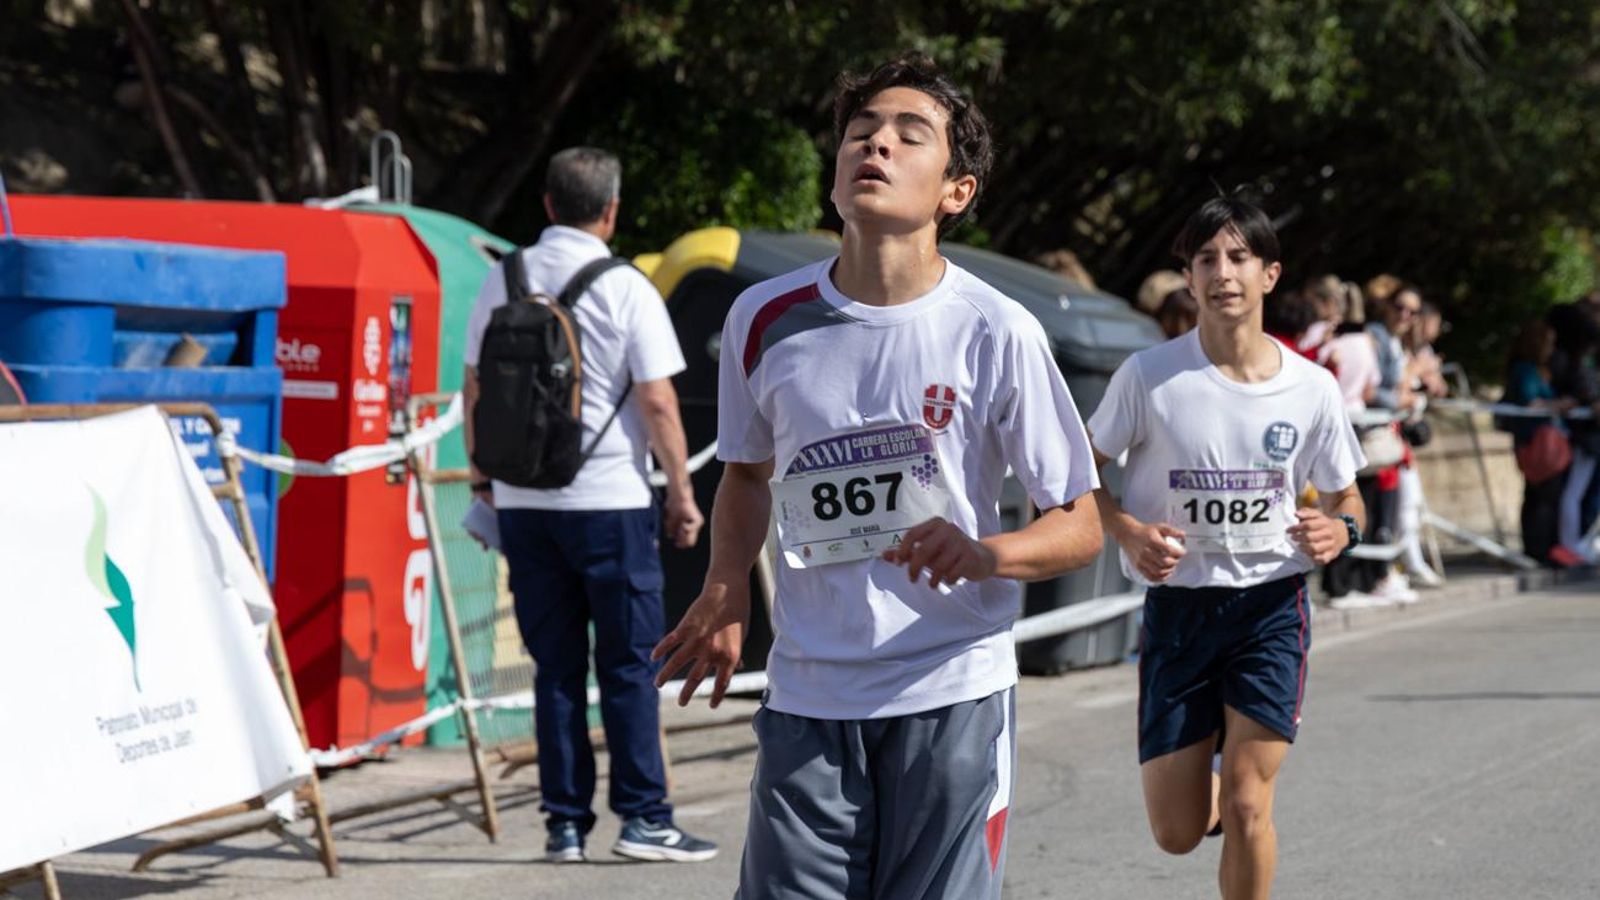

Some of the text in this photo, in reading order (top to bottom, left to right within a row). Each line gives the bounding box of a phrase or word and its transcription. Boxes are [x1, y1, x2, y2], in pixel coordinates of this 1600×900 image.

[852, 434, 888, 449] CARRERA
[861, 440, 918, 458] LA GLORIA
[811, 471, 903, 521] 867
[1184, 498, 1270, 525] 1082
